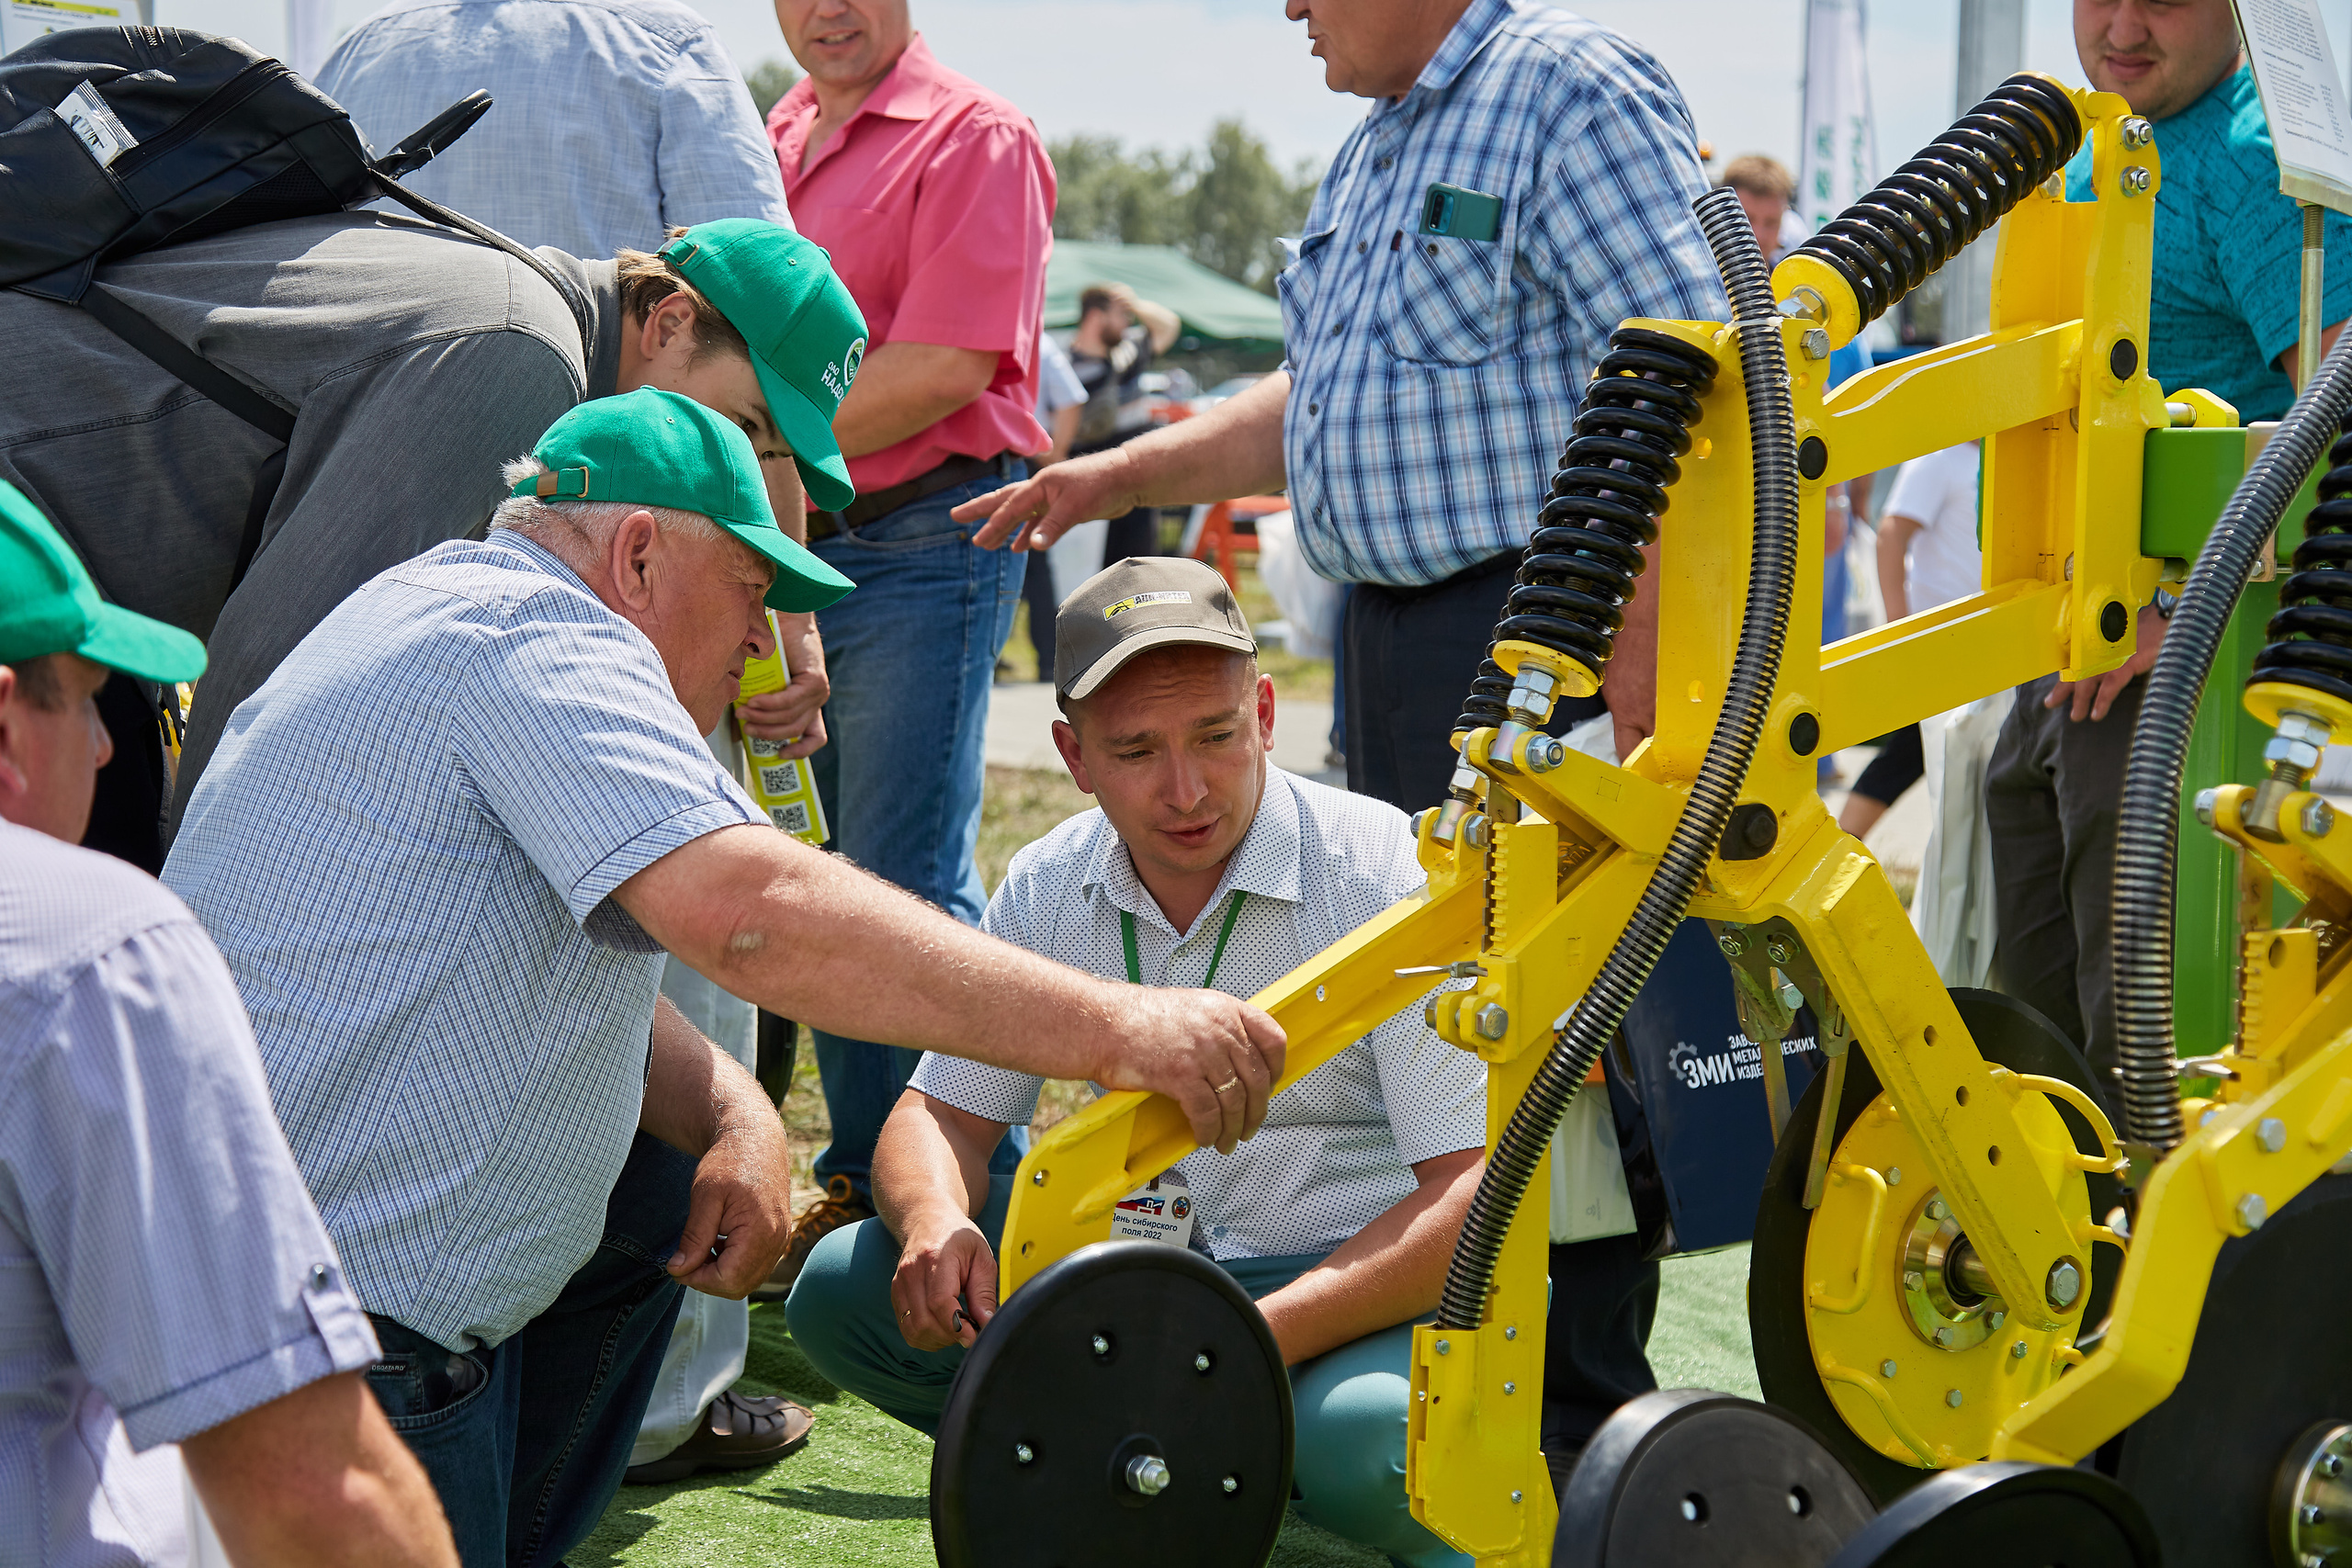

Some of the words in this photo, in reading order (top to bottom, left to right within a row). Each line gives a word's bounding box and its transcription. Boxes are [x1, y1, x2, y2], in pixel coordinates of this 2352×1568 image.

[1727, 1033, 1760, 1049] ЗАВ
[1682, 1052, 1736, 1089] ЗМИ
[1132, 1218, 1178, 1232] сибирского
[1122, 1227, 1142, 1236] поля
[1143, 1229, 1162, 1240] 2022
